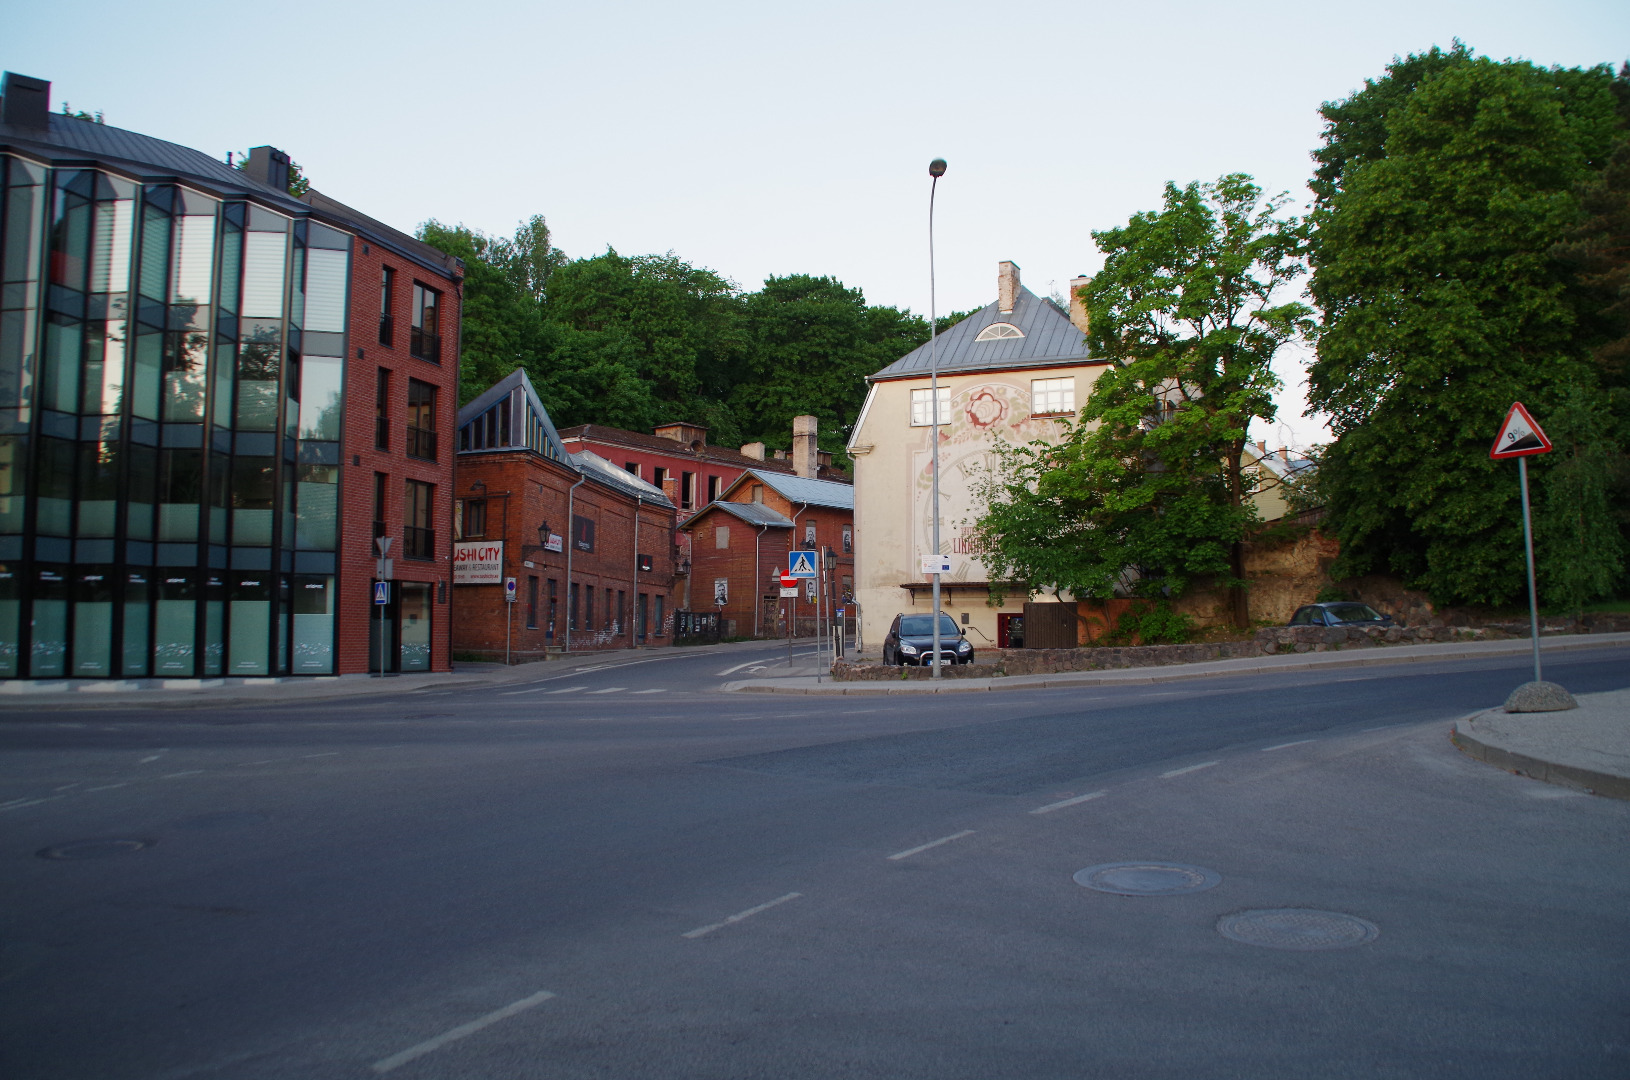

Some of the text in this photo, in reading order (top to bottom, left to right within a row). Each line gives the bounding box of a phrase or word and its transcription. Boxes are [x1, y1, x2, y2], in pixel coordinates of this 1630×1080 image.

[1507, 426, 1525, 442] 9%
[478, 547, 500, 561] CITY
[472, 563, 499, 571] RESTAURANT
